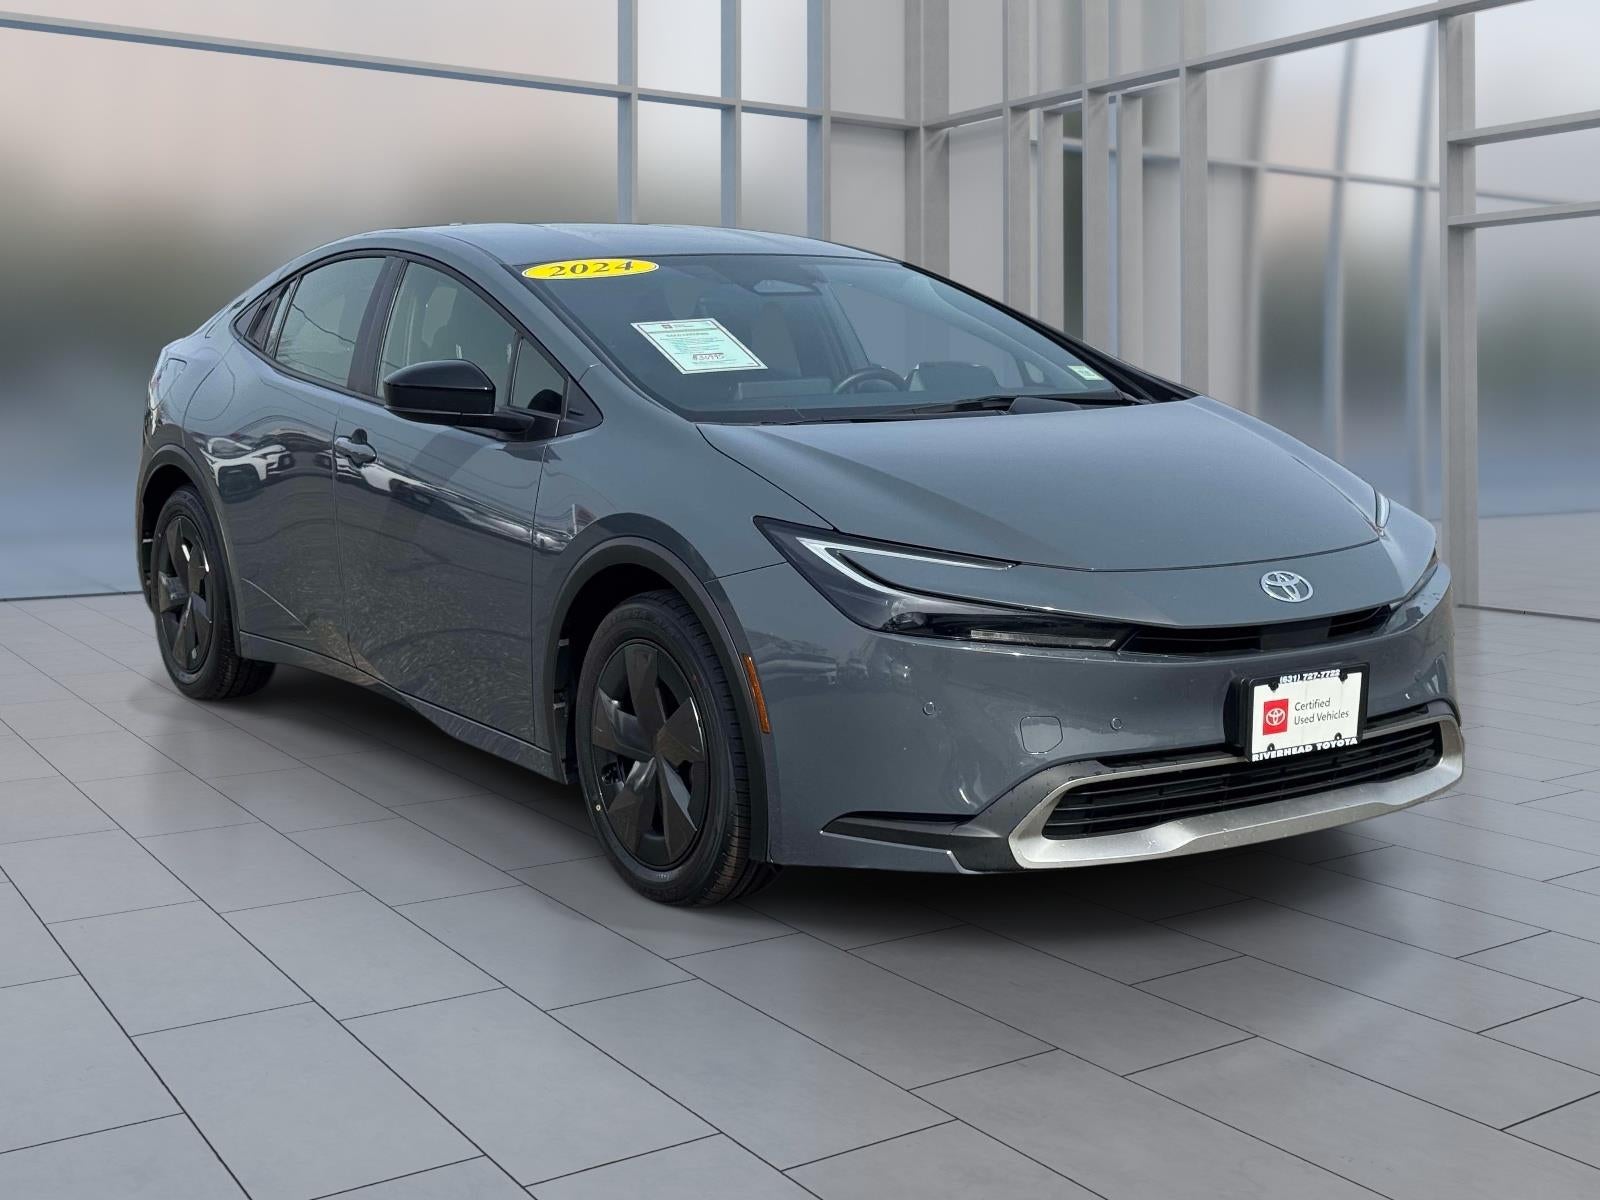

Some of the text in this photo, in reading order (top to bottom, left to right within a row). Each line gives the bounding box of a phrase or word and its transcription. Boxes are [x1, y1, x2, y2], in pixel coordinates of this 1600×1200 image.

[549, 261, 634, 277] 2024
[1302, 669, 1340, 681] 727-7722
[1294, 698, 1331, 711] Certified
[1294, 710, 1349, 726] Used Vehicles
[1252, 738, 1357, 762] RIVERHEAD TOYOTA
